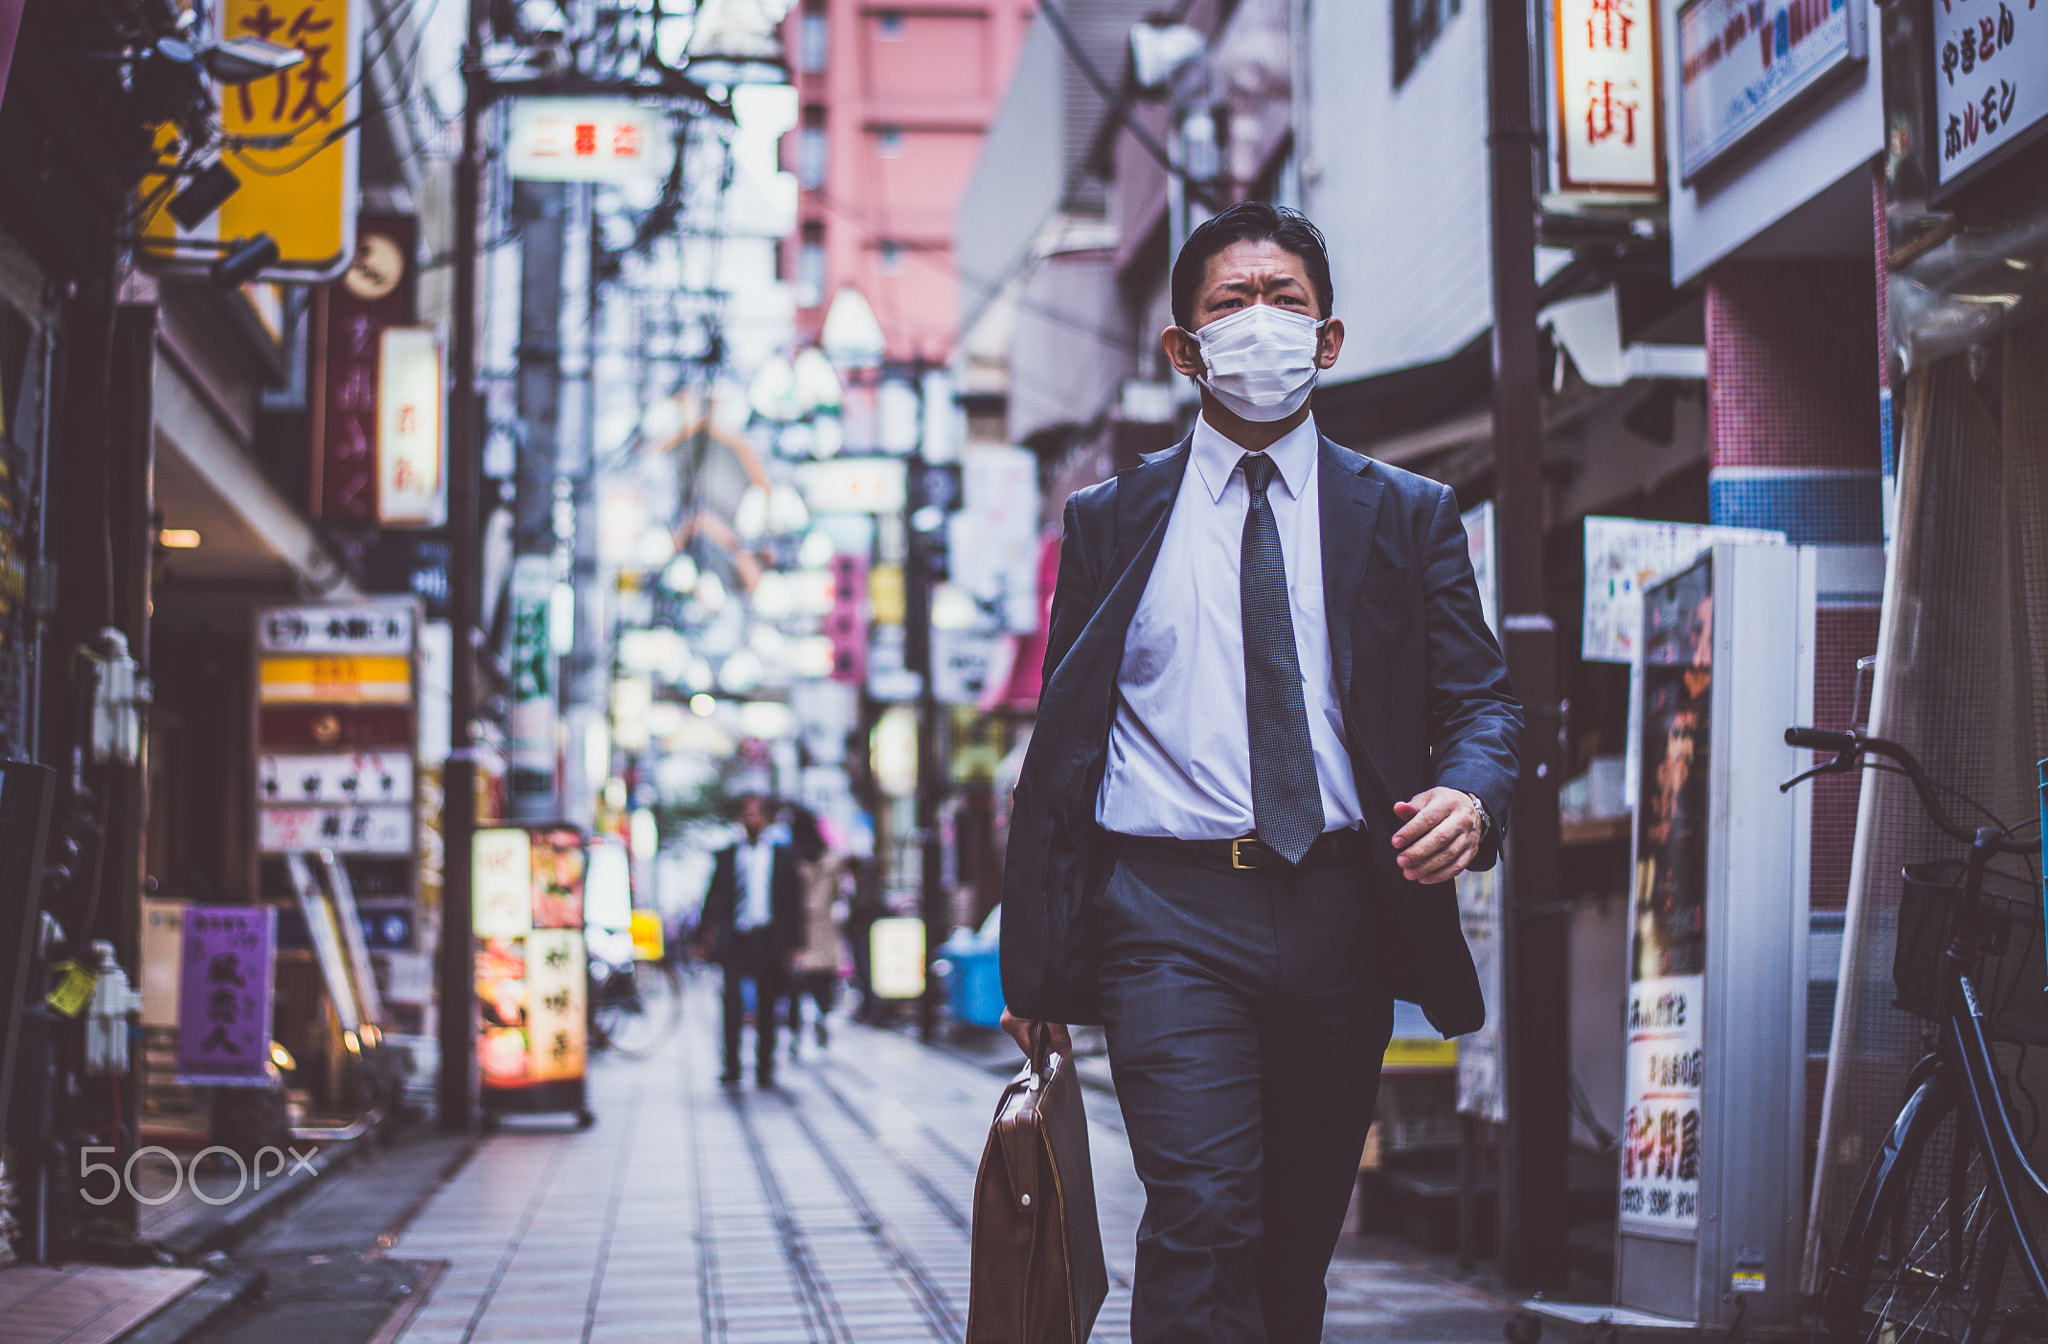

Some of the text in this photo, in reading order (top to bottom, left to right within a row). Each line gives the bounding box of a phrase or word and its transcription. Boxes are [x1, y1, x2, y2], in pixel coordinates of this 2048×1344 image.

[1941, 2, 2015, 87] やきとん
[1943, 78, 2017, 162] ホルモン
